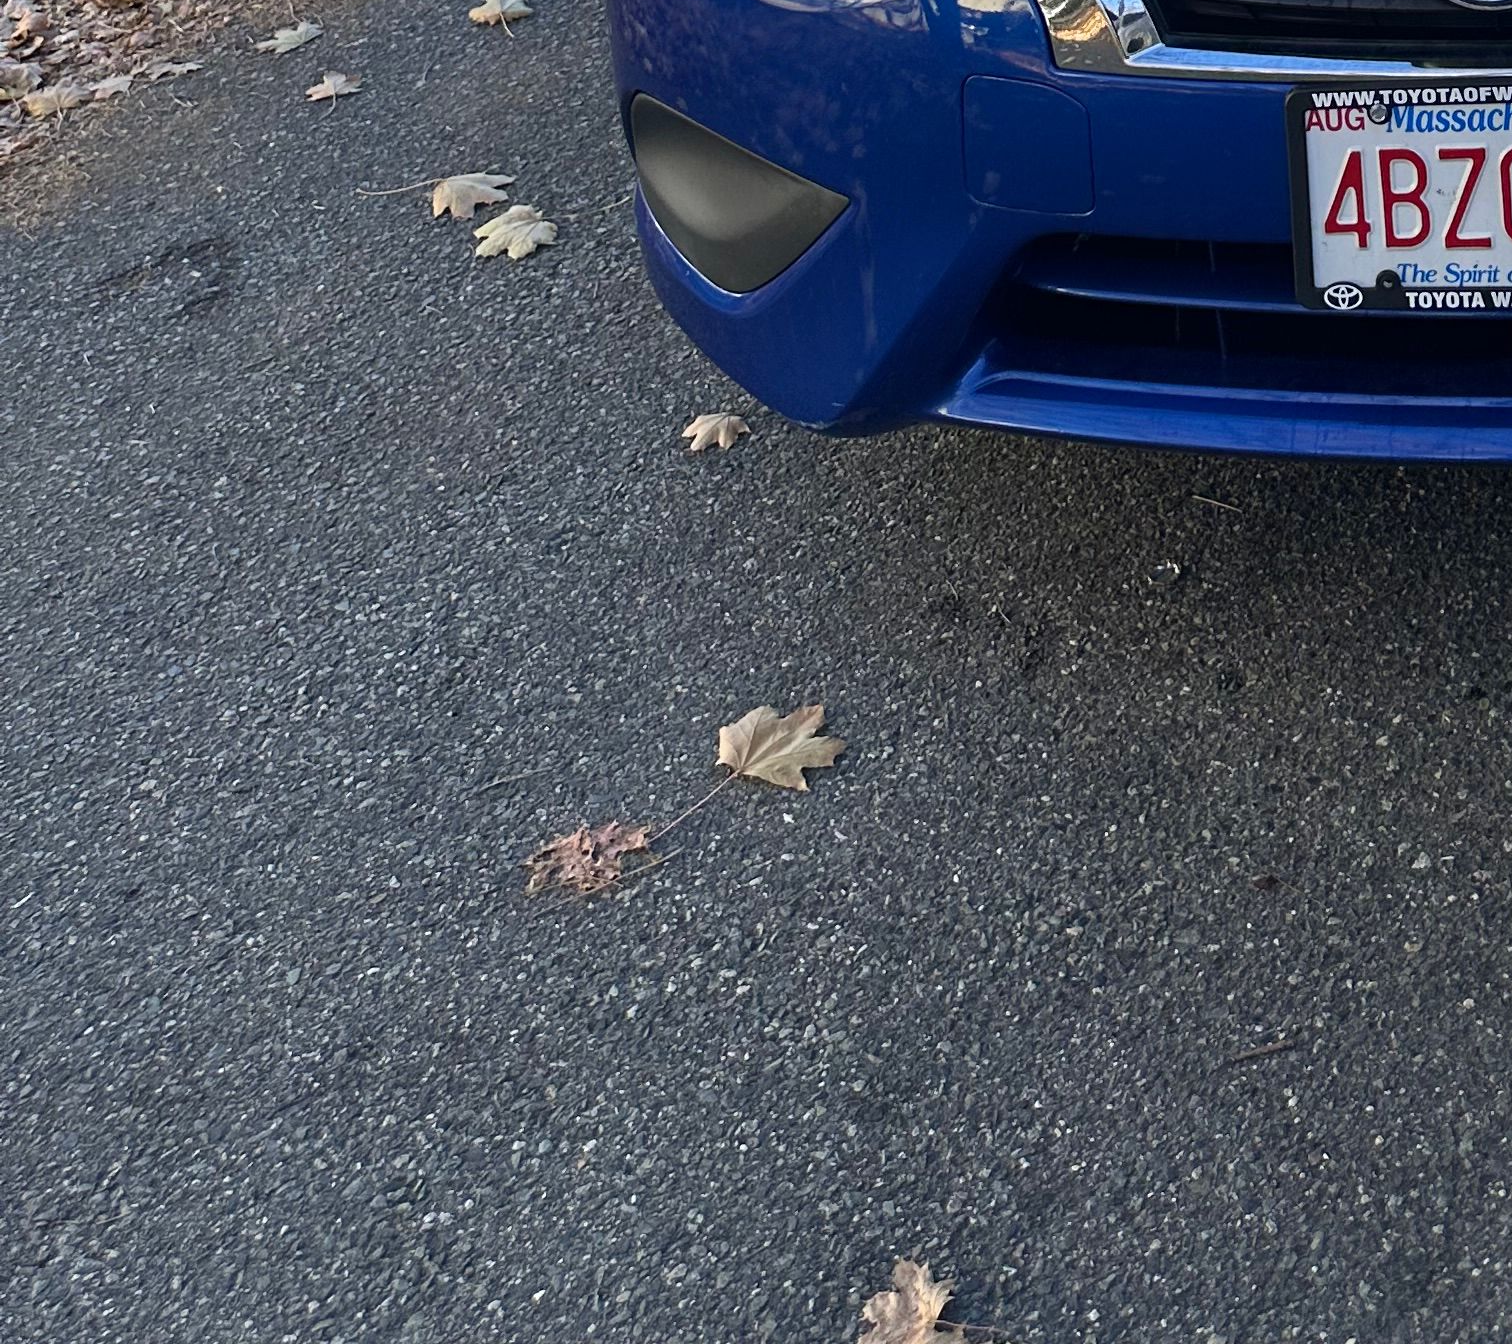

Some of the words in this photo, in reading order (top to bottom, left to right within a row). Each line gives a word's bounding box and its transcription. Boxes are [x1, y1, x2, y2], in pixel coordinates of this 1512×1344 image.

[1306, 108, 1366, 132] AUG
[1397, 263, 1438, 284] The
[1443, 262, 1500, 287] Spirit
[1405, 291, 1486, 309] TOYOTA
